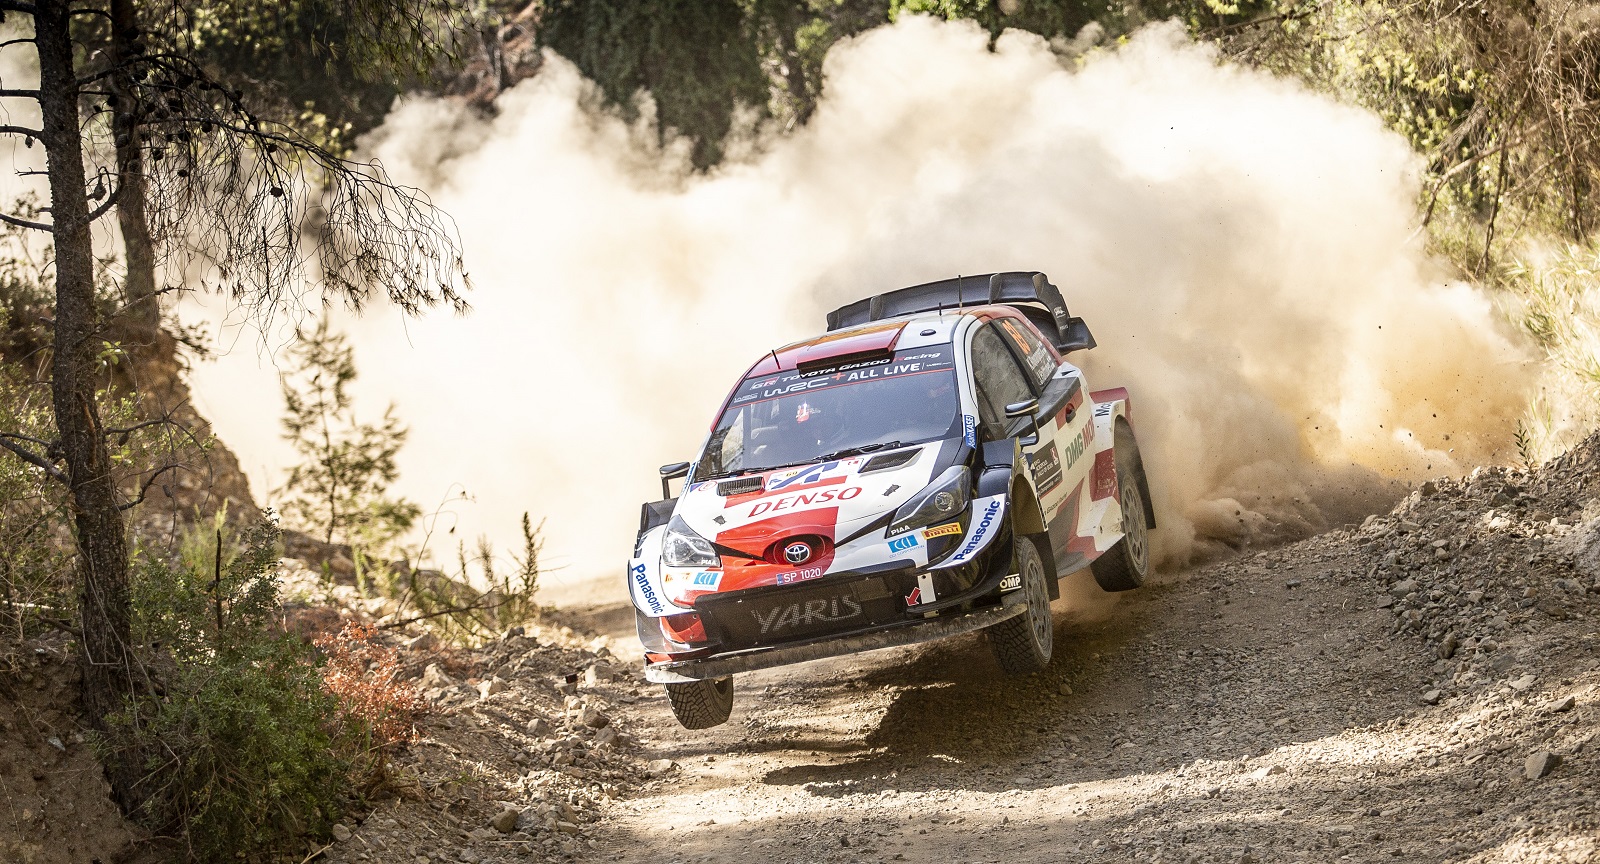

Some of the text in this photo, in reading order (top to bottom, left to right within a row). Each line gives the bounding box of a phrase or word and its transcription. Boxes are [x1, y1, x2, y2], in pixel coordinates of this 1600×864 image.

[781, 367, 836, 382] TOYOTA
[838, 358, 891, 371] GAZOO
[847, 369, 879, 381] ALL
[883, 362, 921, 375] LIVE
[1065, 432, 1084, 471] DMG
[747, 486, 863, 518] DENSO
[890, 524, 911, 536] PIAA
[924, 524, 959, 538] PIRELLI
[952, 500, 1001, 561] Panasonic
[783, 567, 822, 583] SP 1020
[999, 576, 1021, 589] OMP
[631, 563, 665, 614] Panasonic
[750, 594, 862, 634] YARIS
